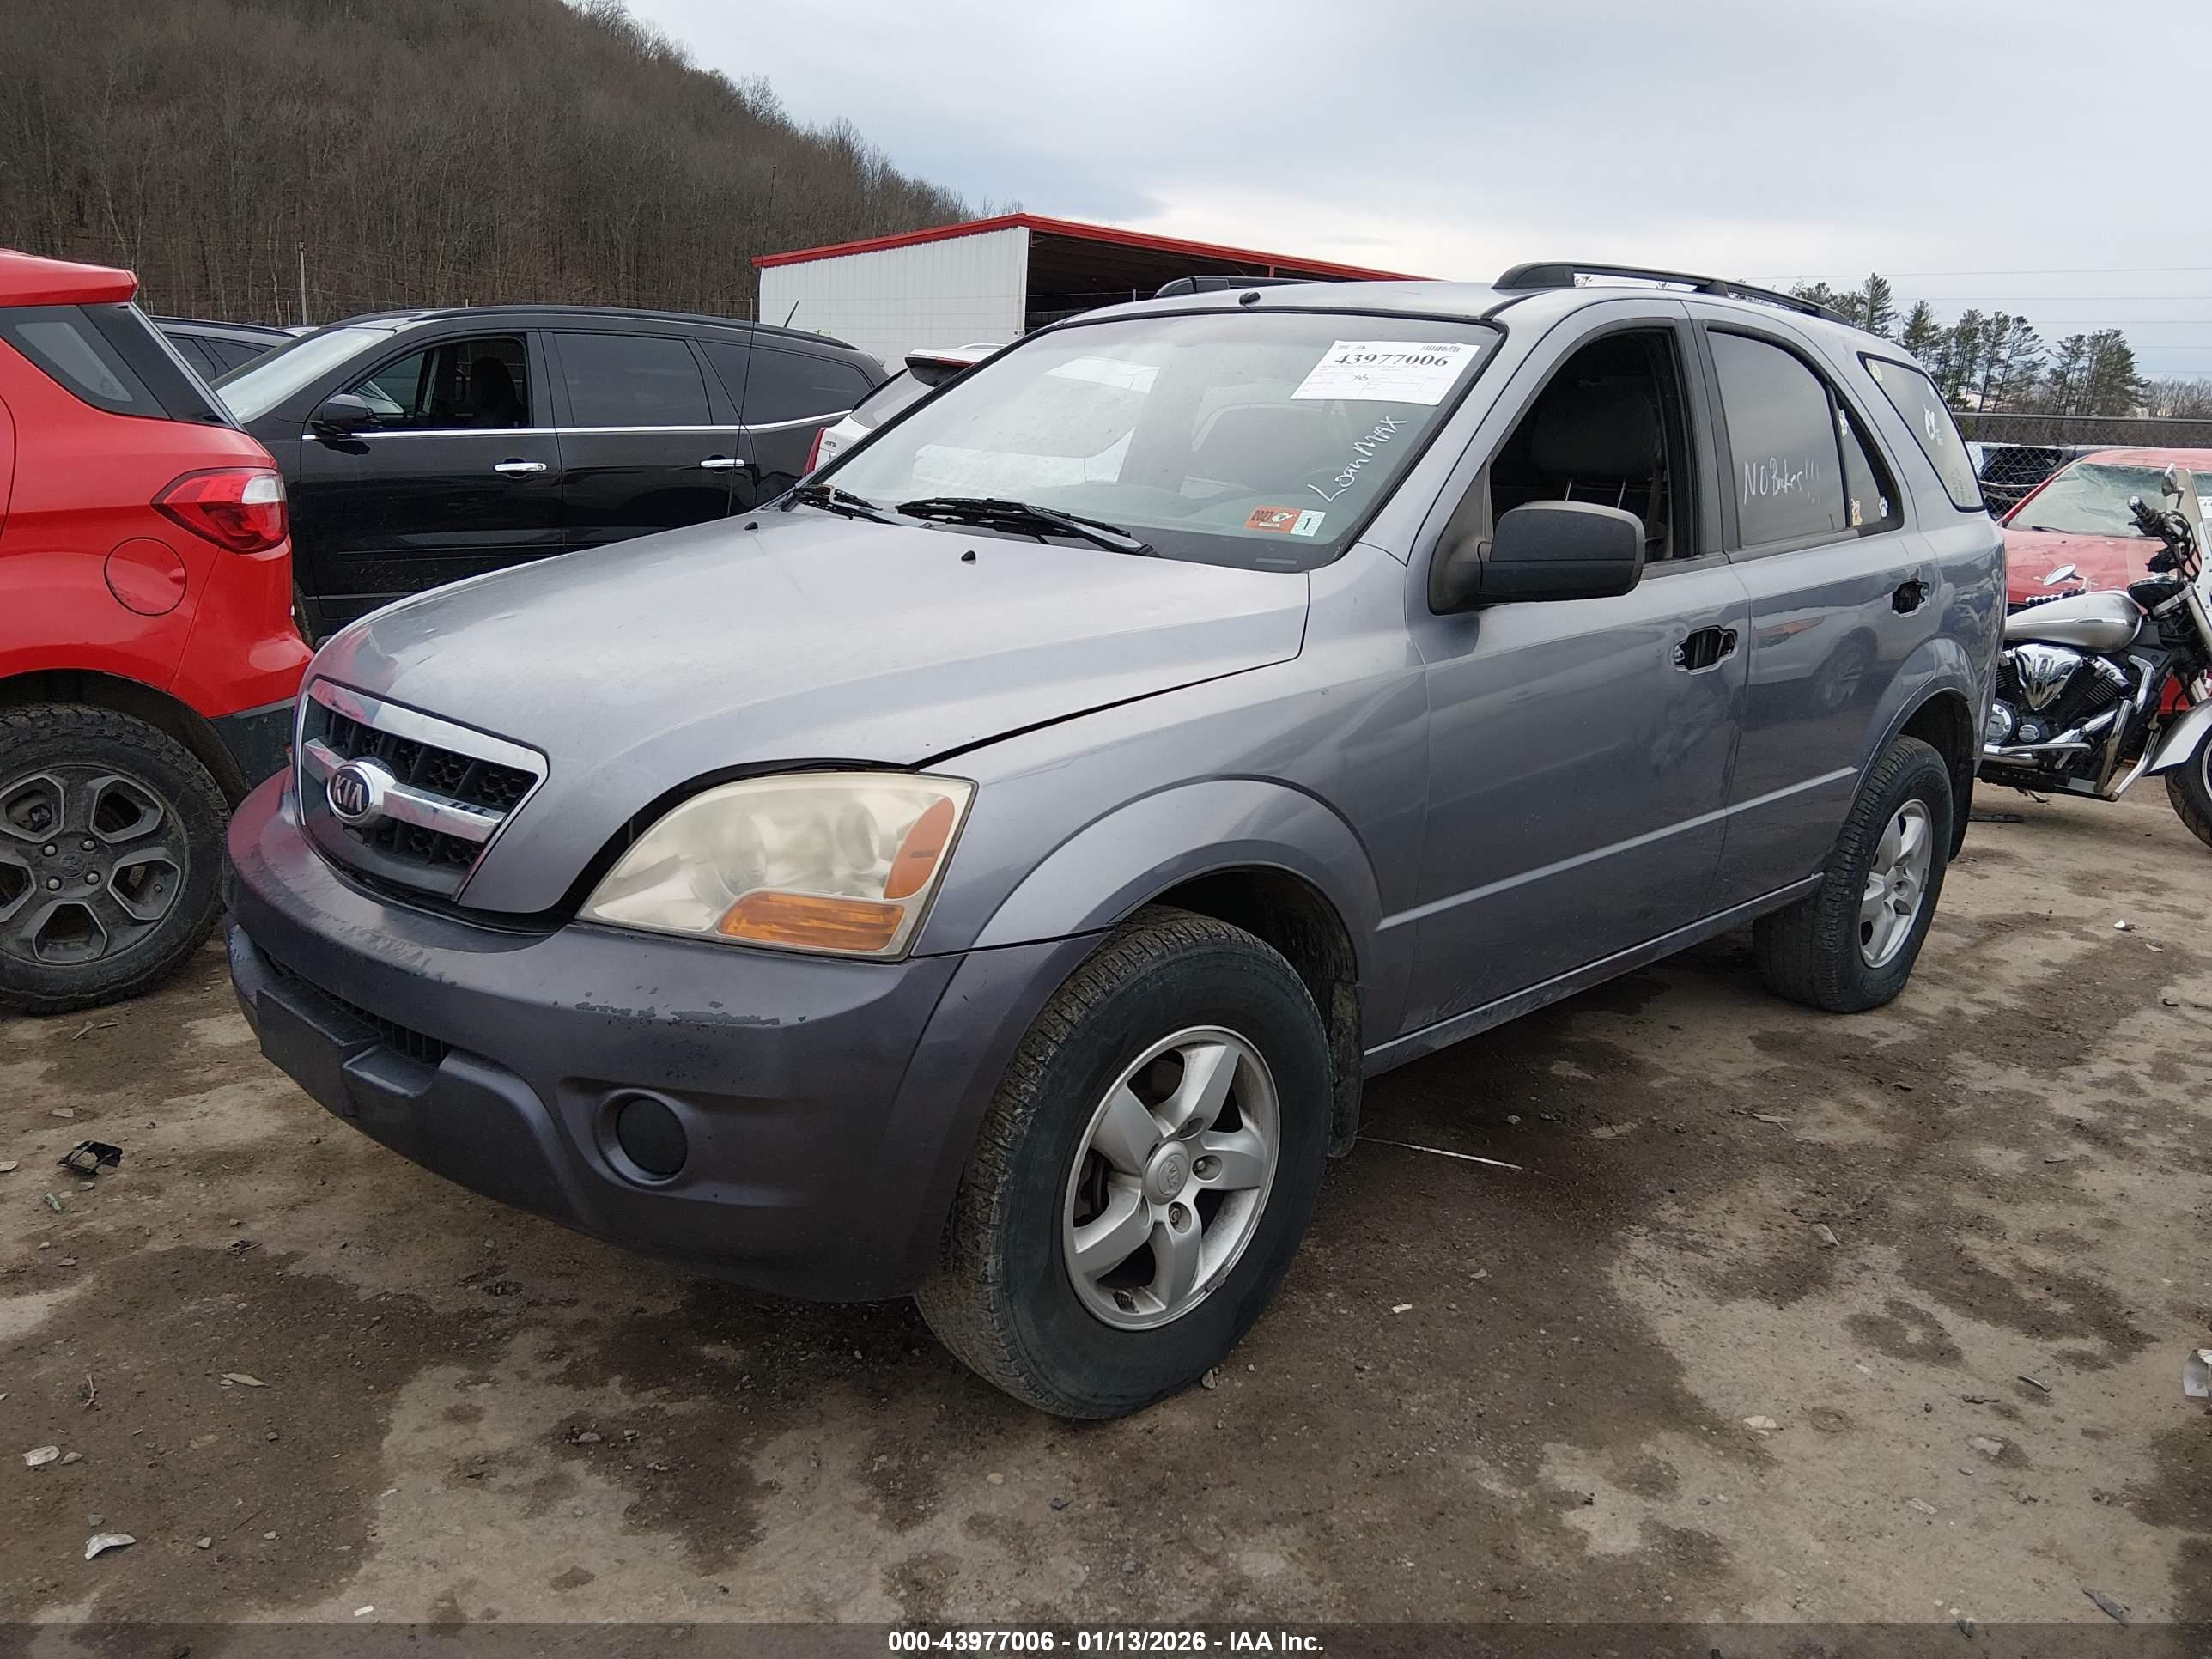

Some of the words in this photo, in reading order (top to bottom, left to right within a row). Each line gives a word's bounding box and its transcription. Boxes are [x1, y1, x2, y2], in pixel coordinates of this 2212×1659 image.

[1334, 353, 1449, 367] 43977006
[1304, 516, 1313, 531] 1
[332, 775, 364, 812] KIA
